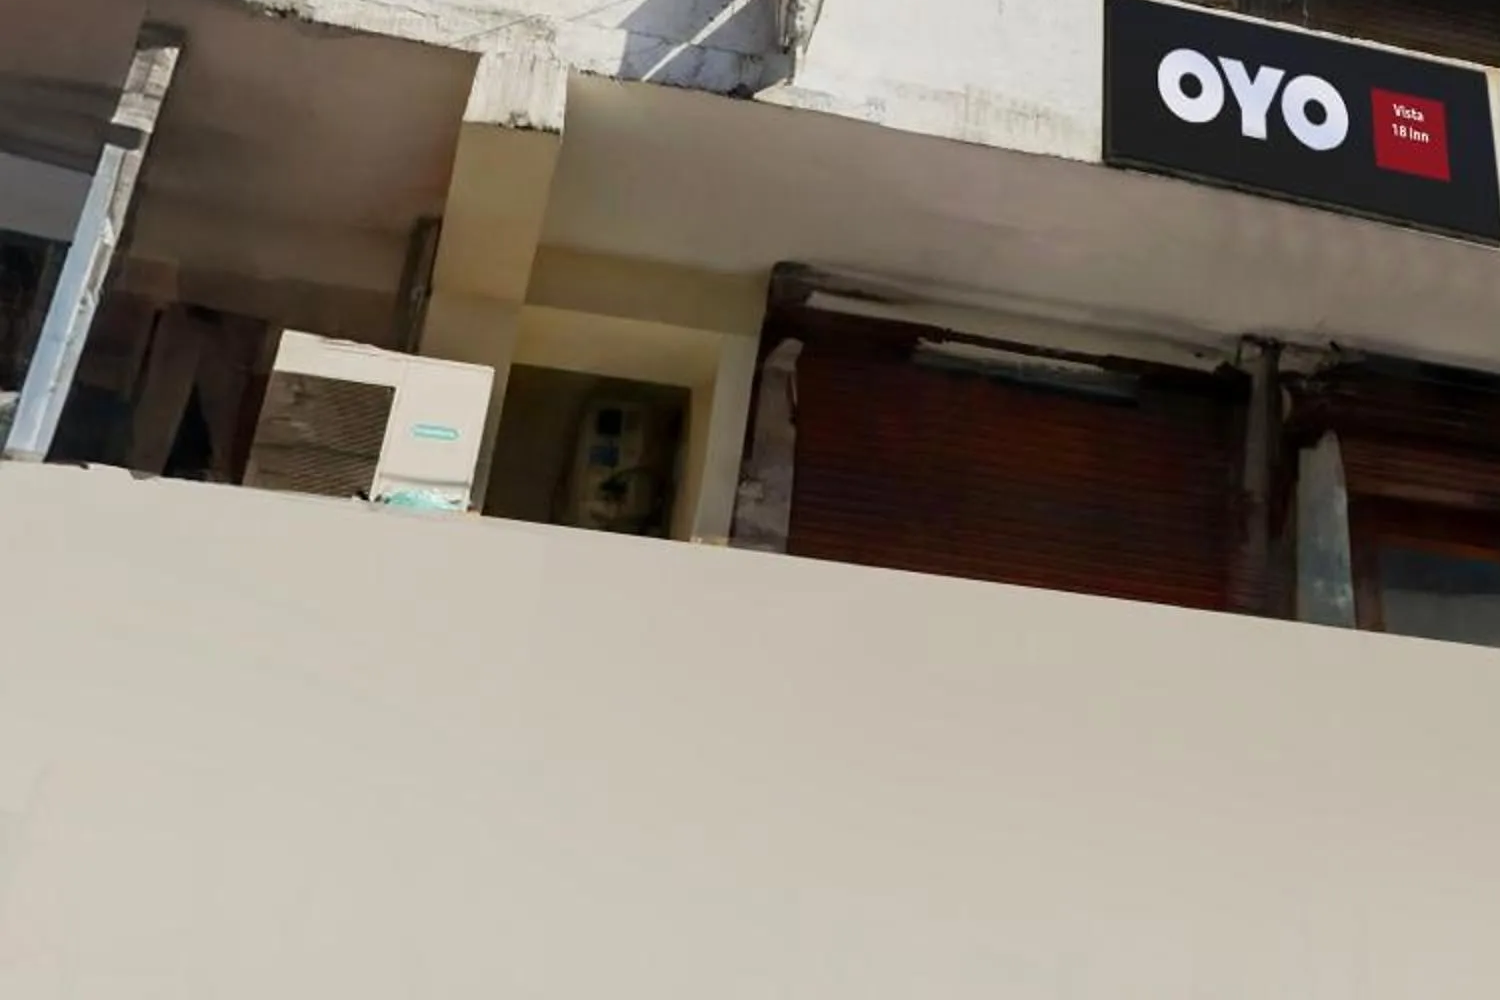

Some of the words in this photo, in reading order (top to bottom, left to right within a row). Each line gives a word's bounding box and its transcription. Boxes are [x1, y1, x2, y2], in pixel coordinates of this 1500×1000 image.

[1158, 47, 1349, 151] OYO
[1393, 103, 1424, 122] Vista
[1391, 123, 1407, 138] 18
[1409, 125, 1430, 144] Inn
